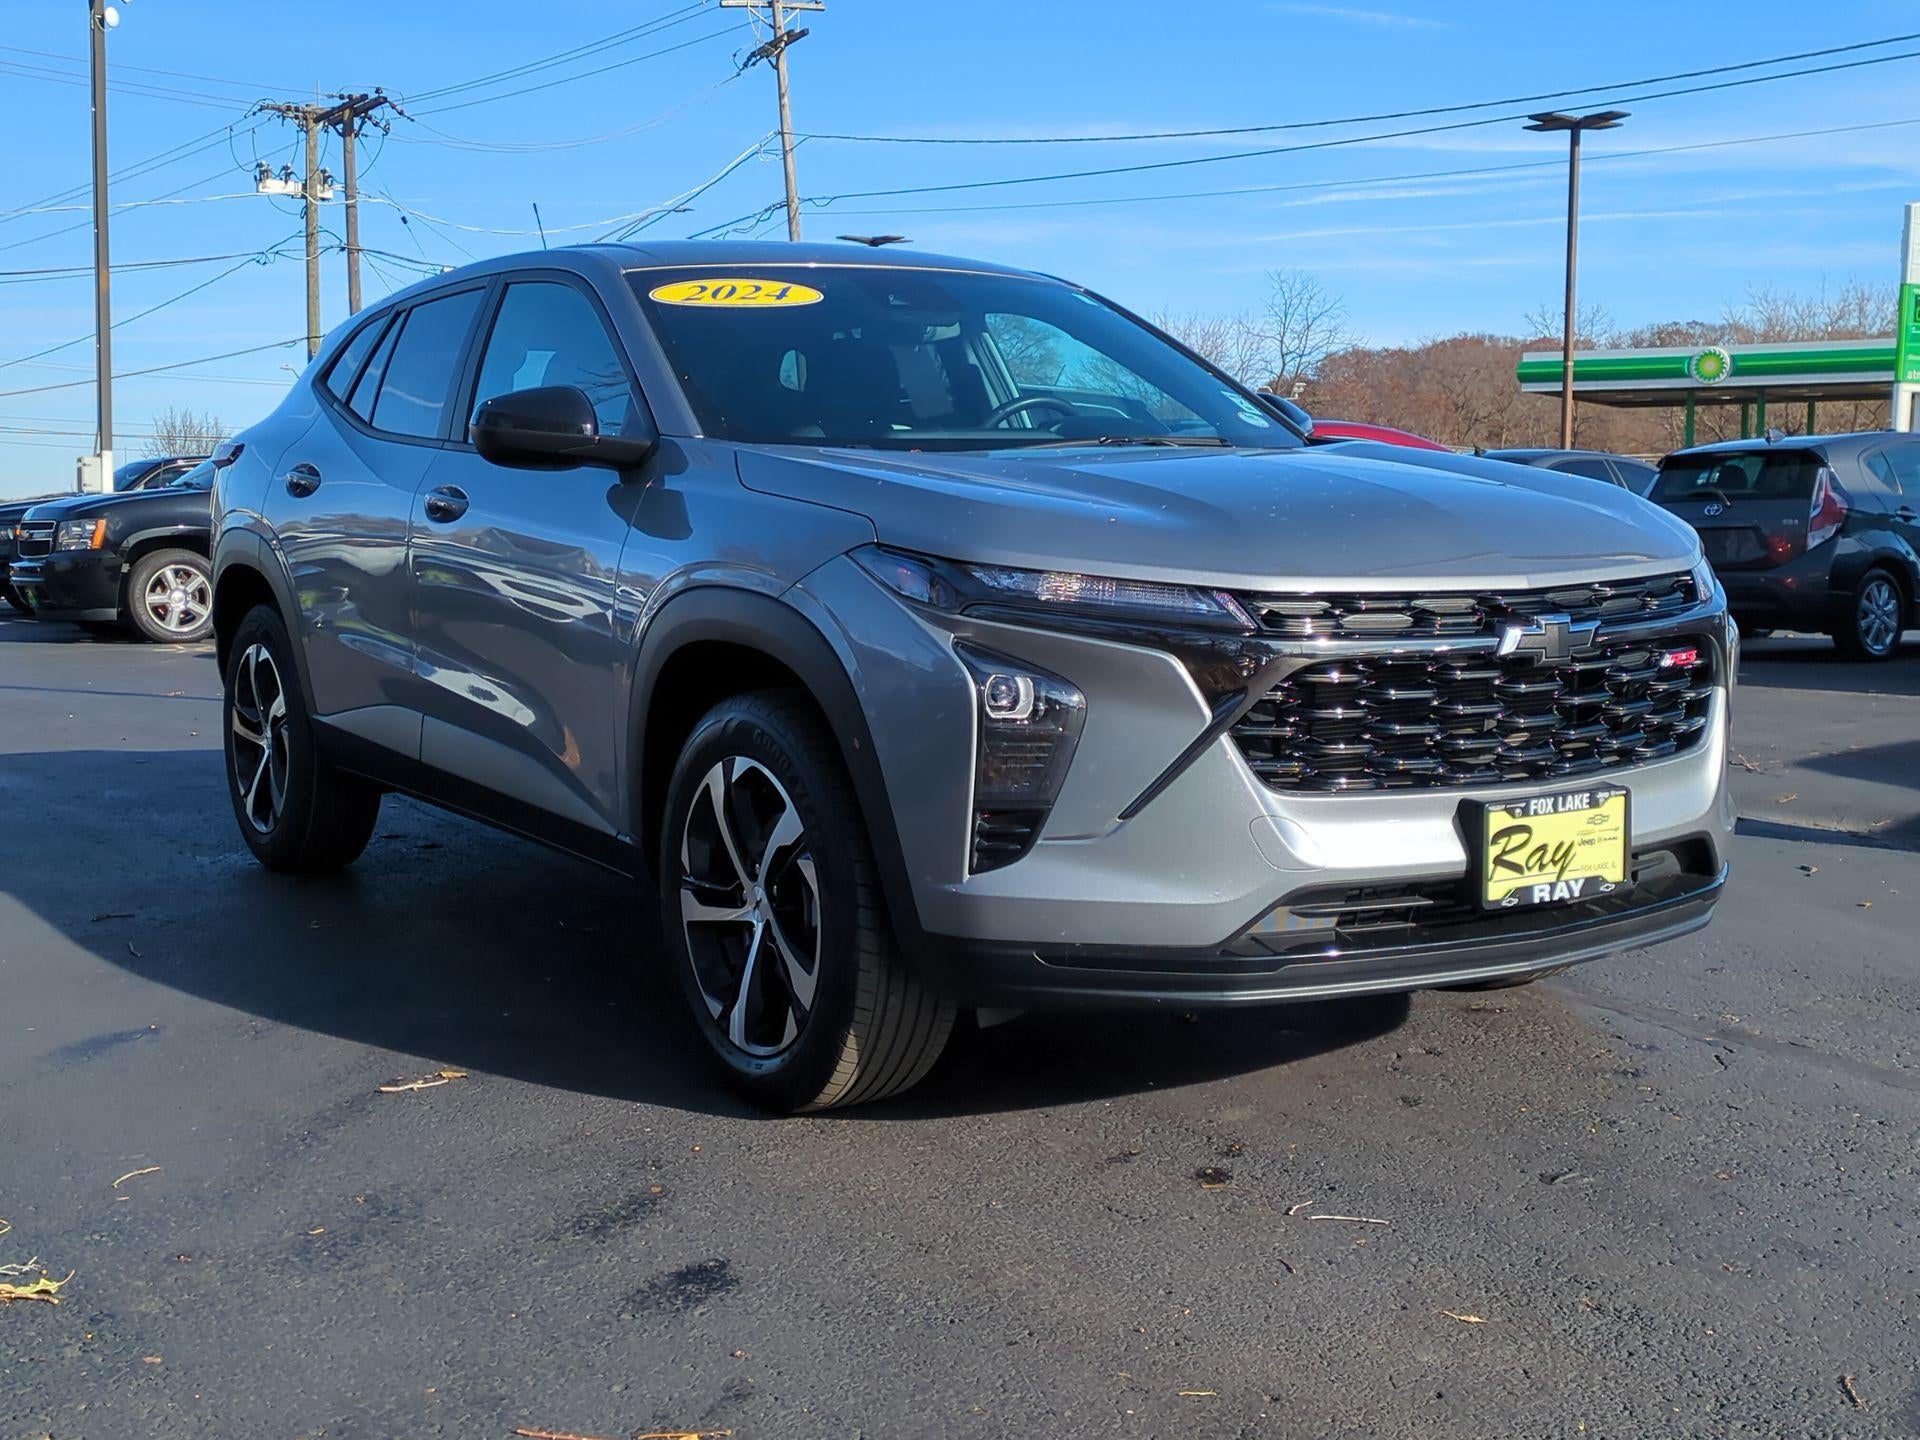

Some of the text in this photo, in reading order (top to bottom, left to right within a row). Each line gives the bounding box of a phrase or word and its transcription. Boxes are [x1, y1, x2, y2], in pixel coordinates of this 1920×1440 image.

[681, 284, 792, 301] 2024
[1669, 649, 1698, 665] RS
[1530, 797, 1554, 815] FOX
[1557, 793, 1590, 812] LAKE
[1577, 837, 1596, 847] Jeep
[1488, 824, 1576, 882] Ray
[1532, 879, 1585, 903] RAY
